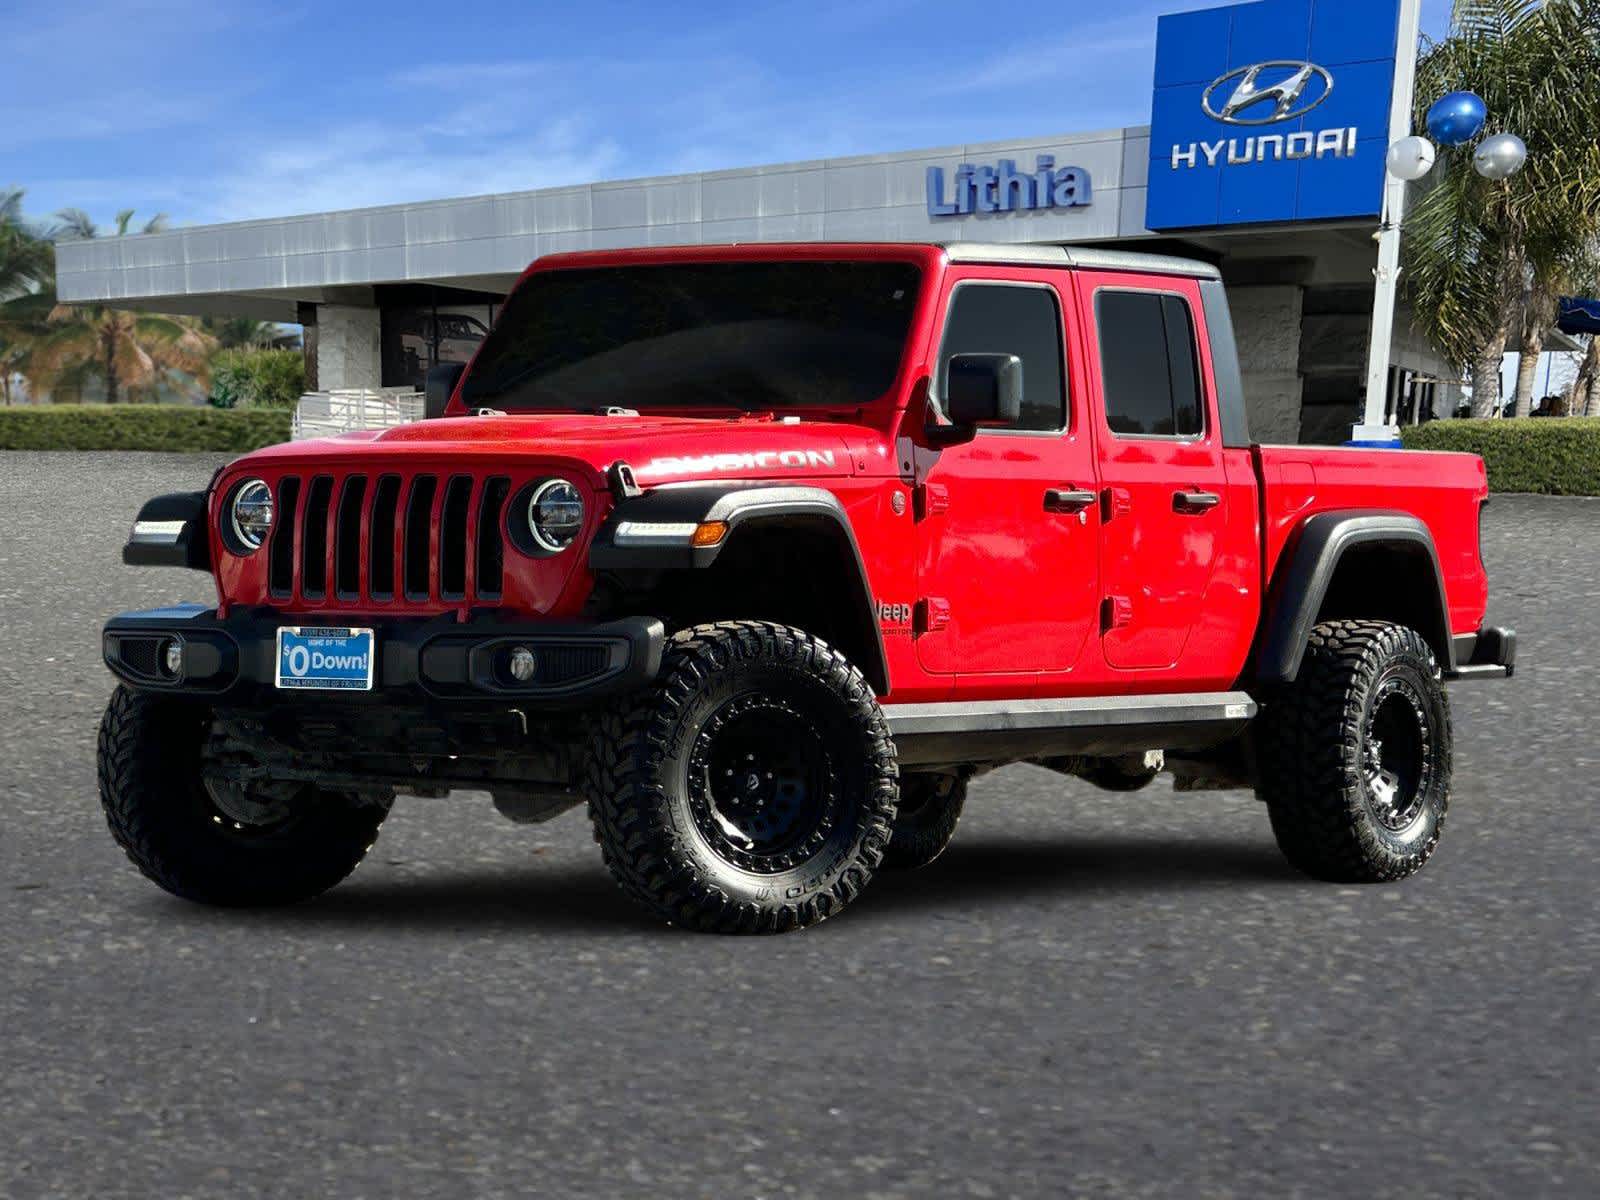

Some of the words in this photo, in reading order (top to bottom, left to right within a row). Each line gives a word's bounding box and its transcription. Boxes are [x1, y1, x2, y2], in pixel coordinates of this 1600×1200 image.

[1170, 126, 1357, 169] HYUNDAI
[926, 155, 1092, 217] Lithia
[650, 450, 835, 474] RUBICON
[875, 599, 911, 625] Jeep
[312, 652, 367, 669] Down!
